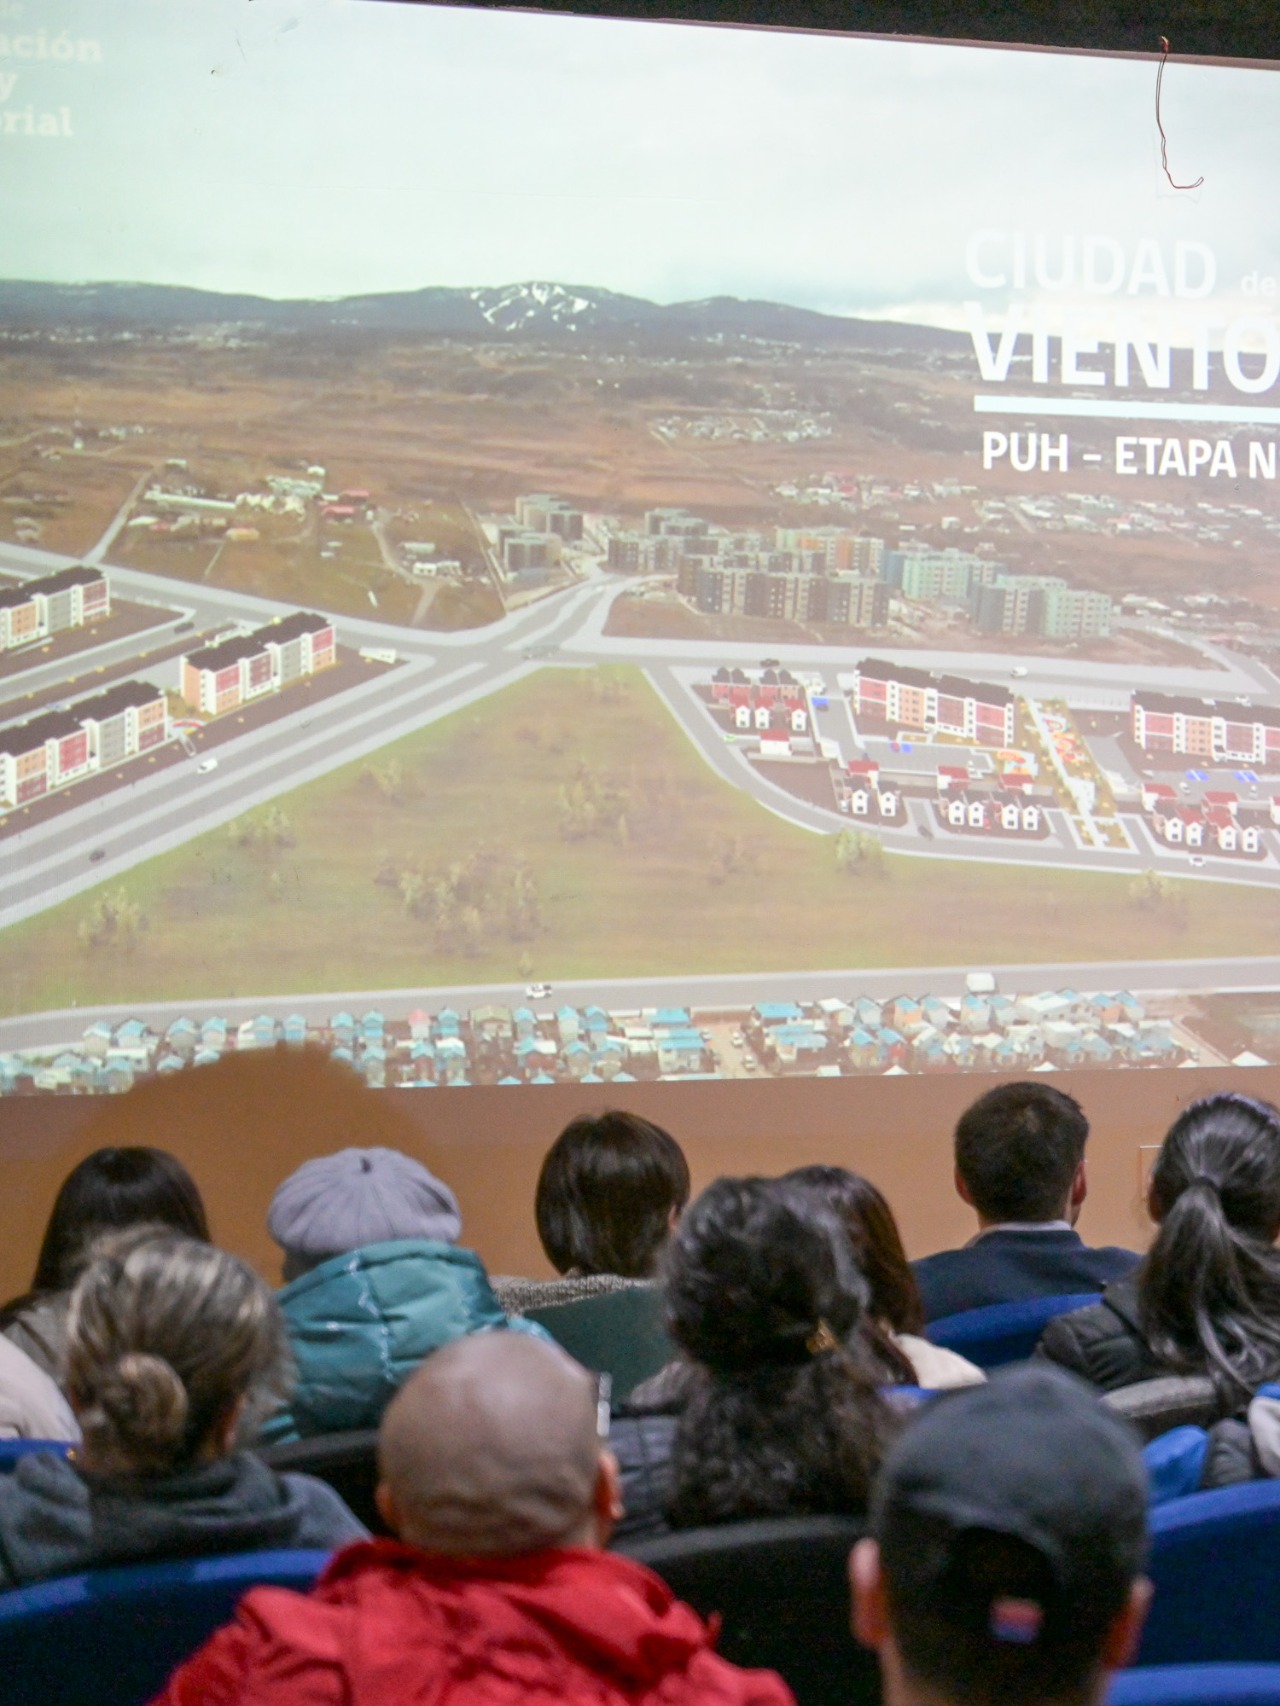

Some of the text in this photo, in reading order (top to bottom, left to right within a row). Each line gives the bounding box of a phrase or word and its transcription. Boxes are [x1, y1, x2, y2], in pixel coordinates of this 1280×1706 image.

[964, 229, 1217, 298] CIUDAD
[1241, 270, 1277, 297] de
[982, 431, 1069, 472] PUH
[1116, 436, 1237, 479] ETAPA
